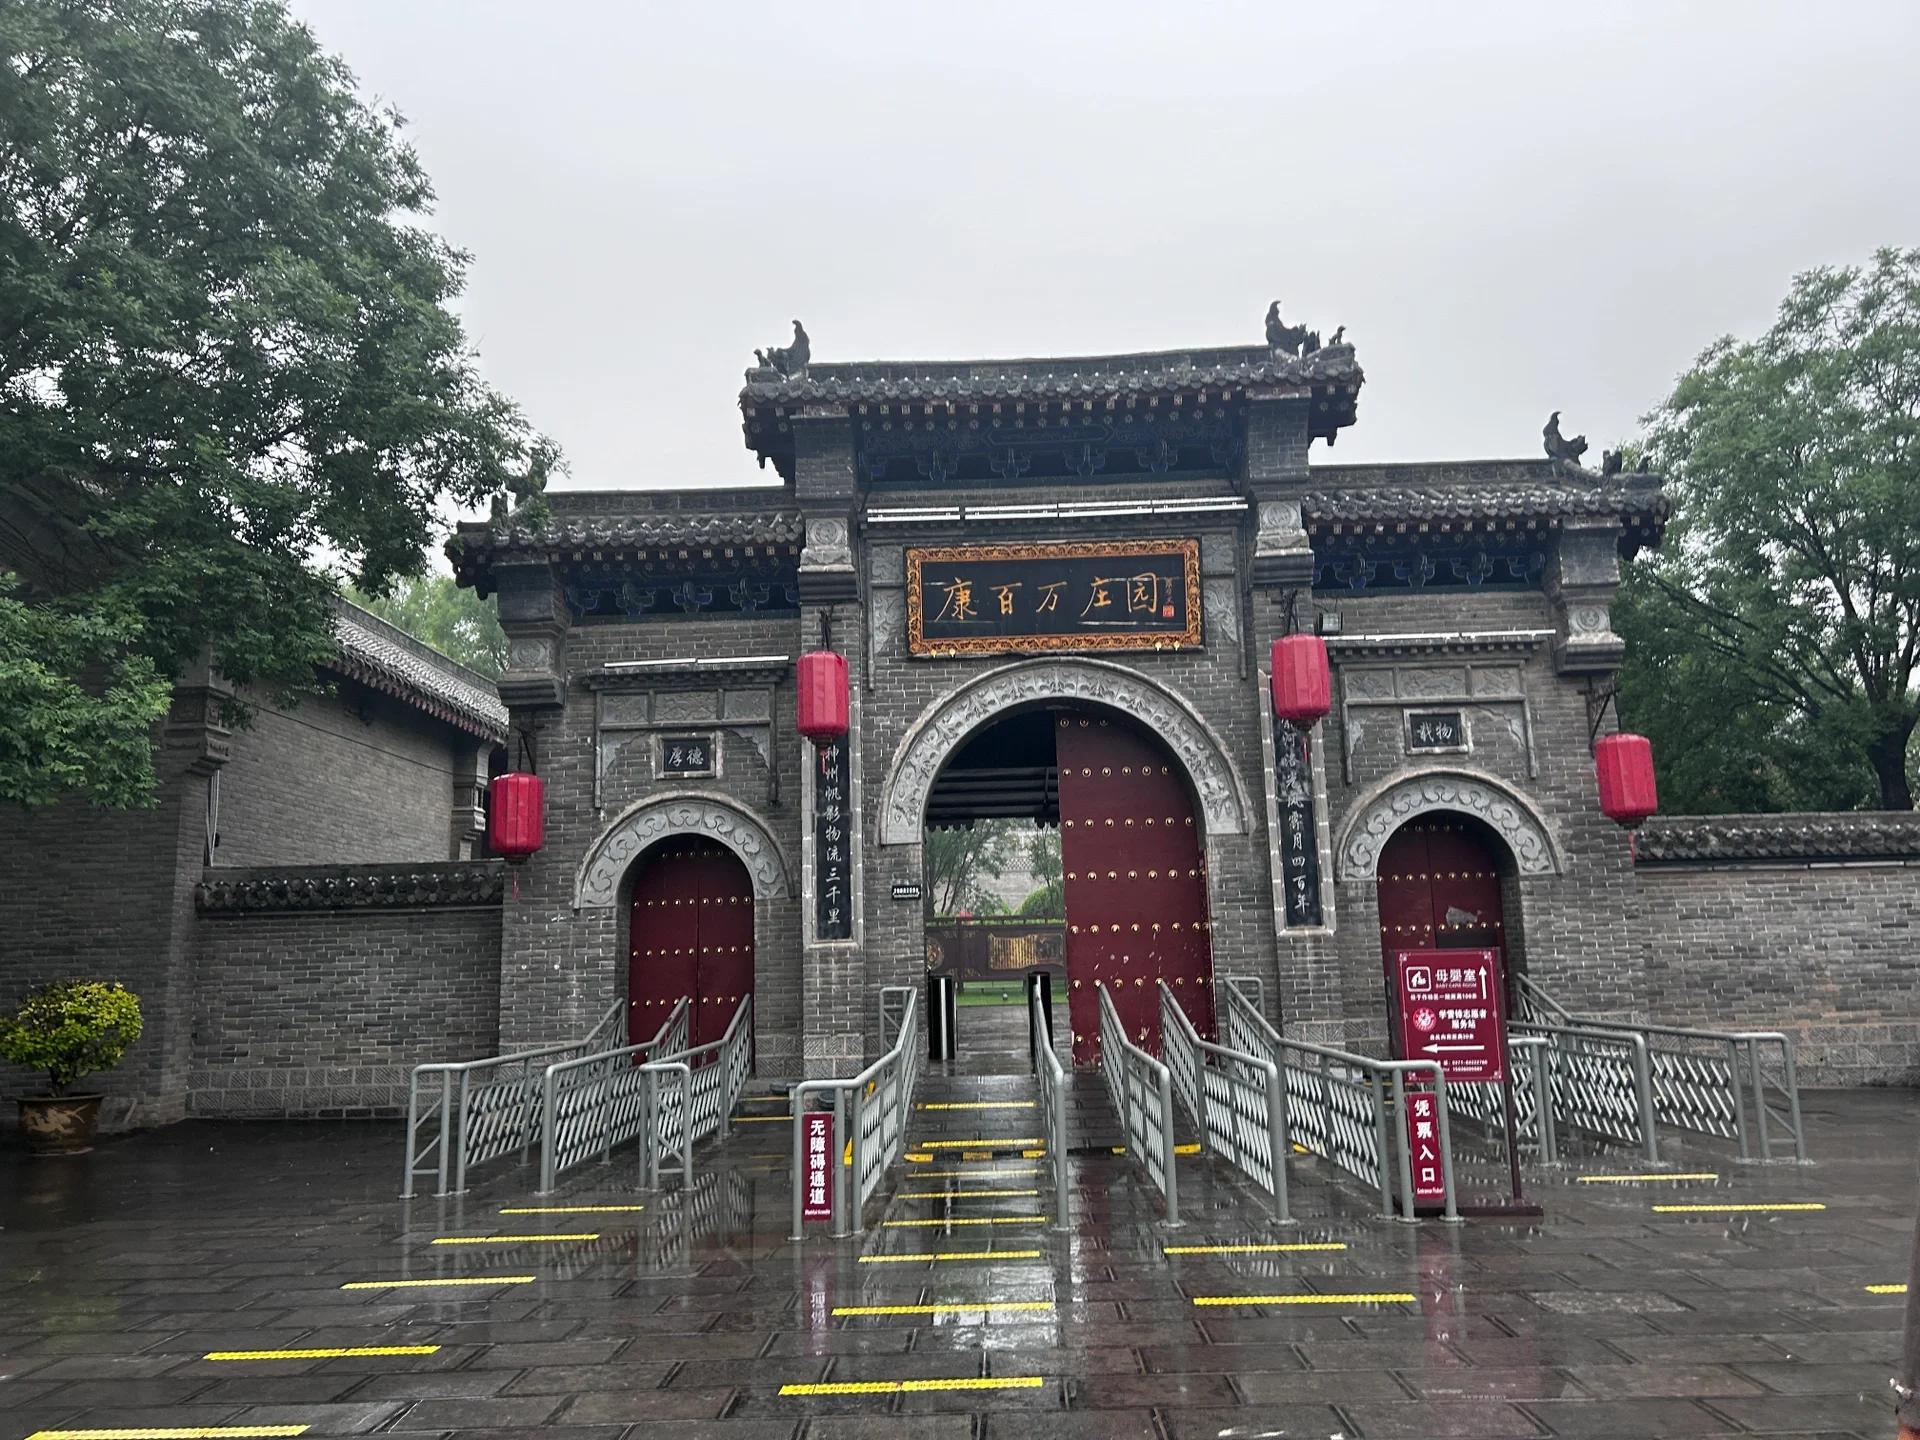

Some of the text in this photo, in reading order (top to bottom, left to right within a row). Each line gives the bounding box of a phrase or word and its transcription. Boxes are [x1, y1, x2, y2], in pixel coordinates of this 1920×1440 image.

[934, 572, 1158, 622] 康百万庄园
[1435, 968, 1477, 983] 母婴室
[810, 1120, 826, 1205] 无障碍通道
[1414, 1099, 1435, 1182] 凭票入口
